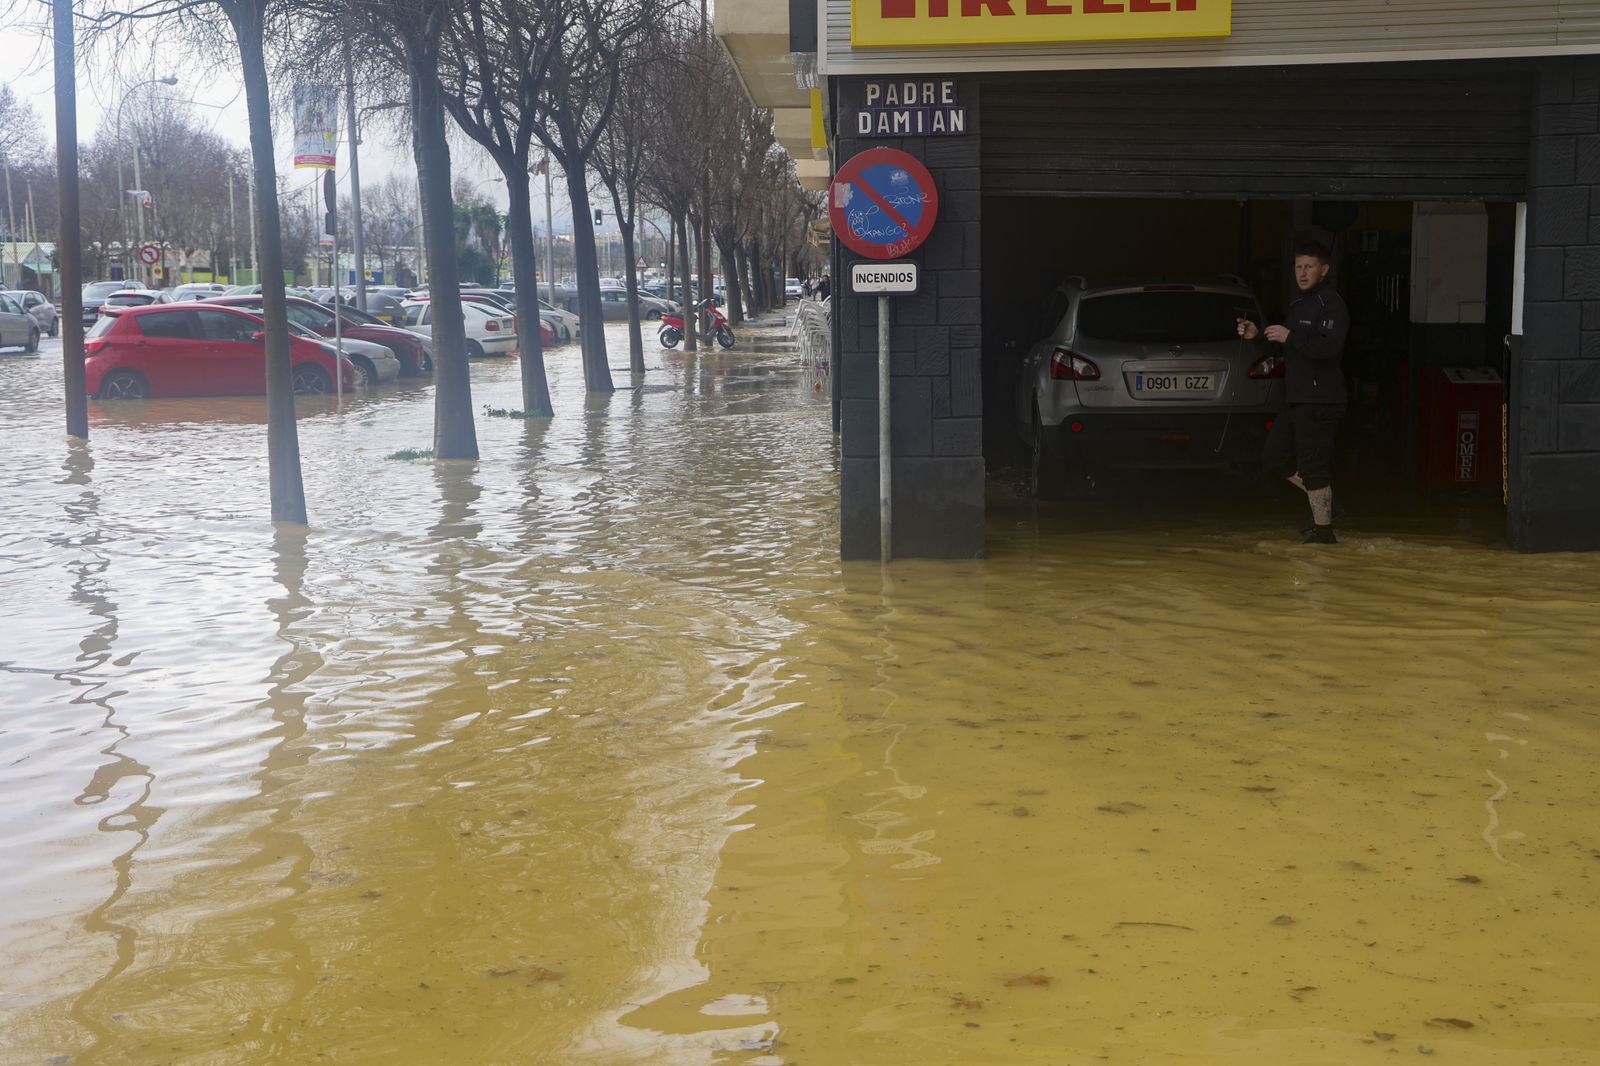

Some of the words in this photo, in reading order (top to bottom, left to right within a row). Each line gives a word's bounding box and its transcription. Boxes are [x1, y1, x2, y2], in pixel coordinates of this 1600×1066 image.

[866, 81, 954, 106] PADRE
[858, 109, 964, 134] DAMIAN
[855, 272, 913, 283] INCENDIOS
[1147, 376, 1177, 389] 0901
[1185, 376, 1209, 389] GZZ
[1459, 431, 1476, 479] OMER
